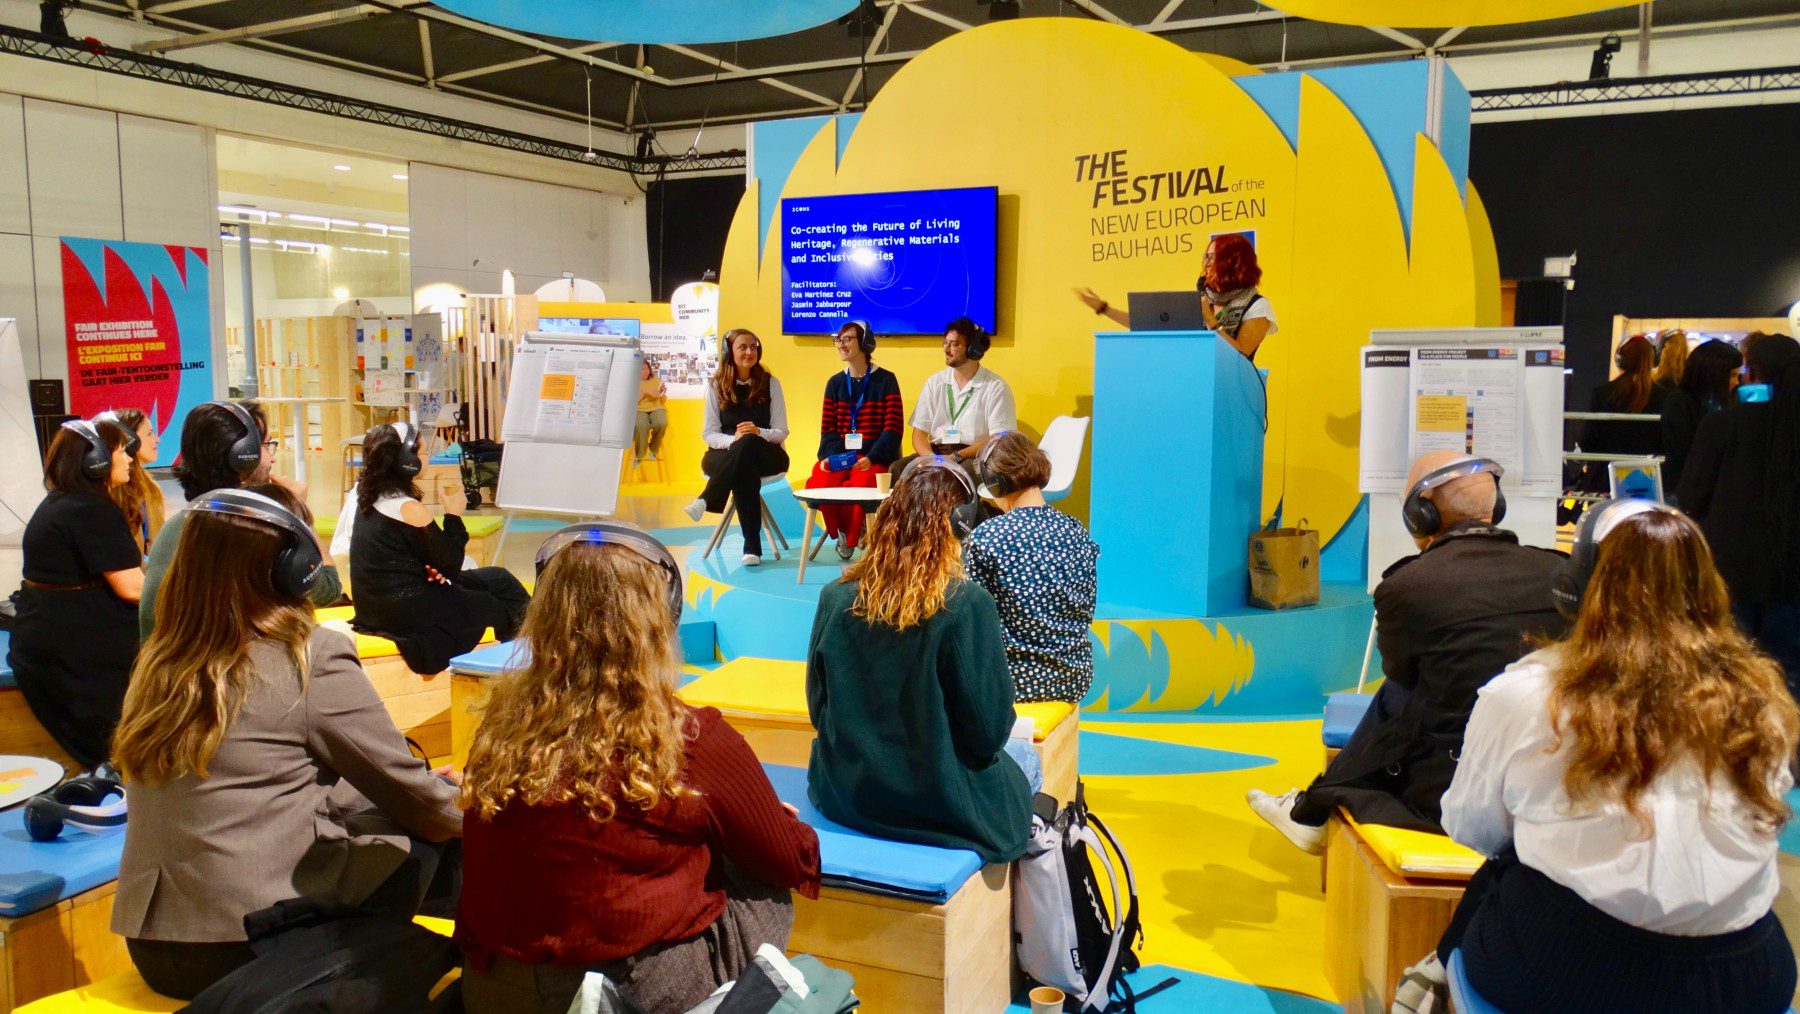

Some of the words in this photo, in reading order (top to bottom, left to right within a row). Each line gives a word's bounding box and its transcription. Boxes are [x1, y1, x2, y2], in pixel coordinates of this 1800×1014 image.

[1075, 150, 1128, 182] THE
[1092, 165, 1229, 209] FESTIVAL
[1231, 179, 1243, 192] of
[1246, 178, 1265, 190] the
[1091, 213, 1140, 237] NEW
[1146, 197, 1266, 230] EUROPEAN
[791, 223, 847, 235] Co-creating
[852, 222, 867, 232] the
[872, 222, 905, 231] Future
[909, 219, 922, 230] of
[926, 217, 960, 230] Living
[791, 239, 836, 250] Heritage,
[841, 235, 905, 249] Regenerative
[909, 233, 960, 245] Materials
[1092, 233, 1193, 262] BAUHAUS
[791, 253, 807, 263] and
[815, 301, 852, 309] Jabbarpour
[819, 310, 848, 318] Cannella
[75, 322, 98, 332] FAIR
[99, 320, 154, 331] EXHIBITION
[76, 331, 131, 341] CONTINUES
[133, 329, 158, 339] HERE
[77, 343, 143, 356] L'EXPOSITION
[145, 342, 166, 352] FAIR
[79, 353, 129, 364] CONTINUE
[130, 352, 142, 361] ICI
[81, 369, 92, 377] DE
[82, 377, 107, 387] GAAT
[110, 375, 131, 385] HIER
[134, 373, 170, 383] VERDER
